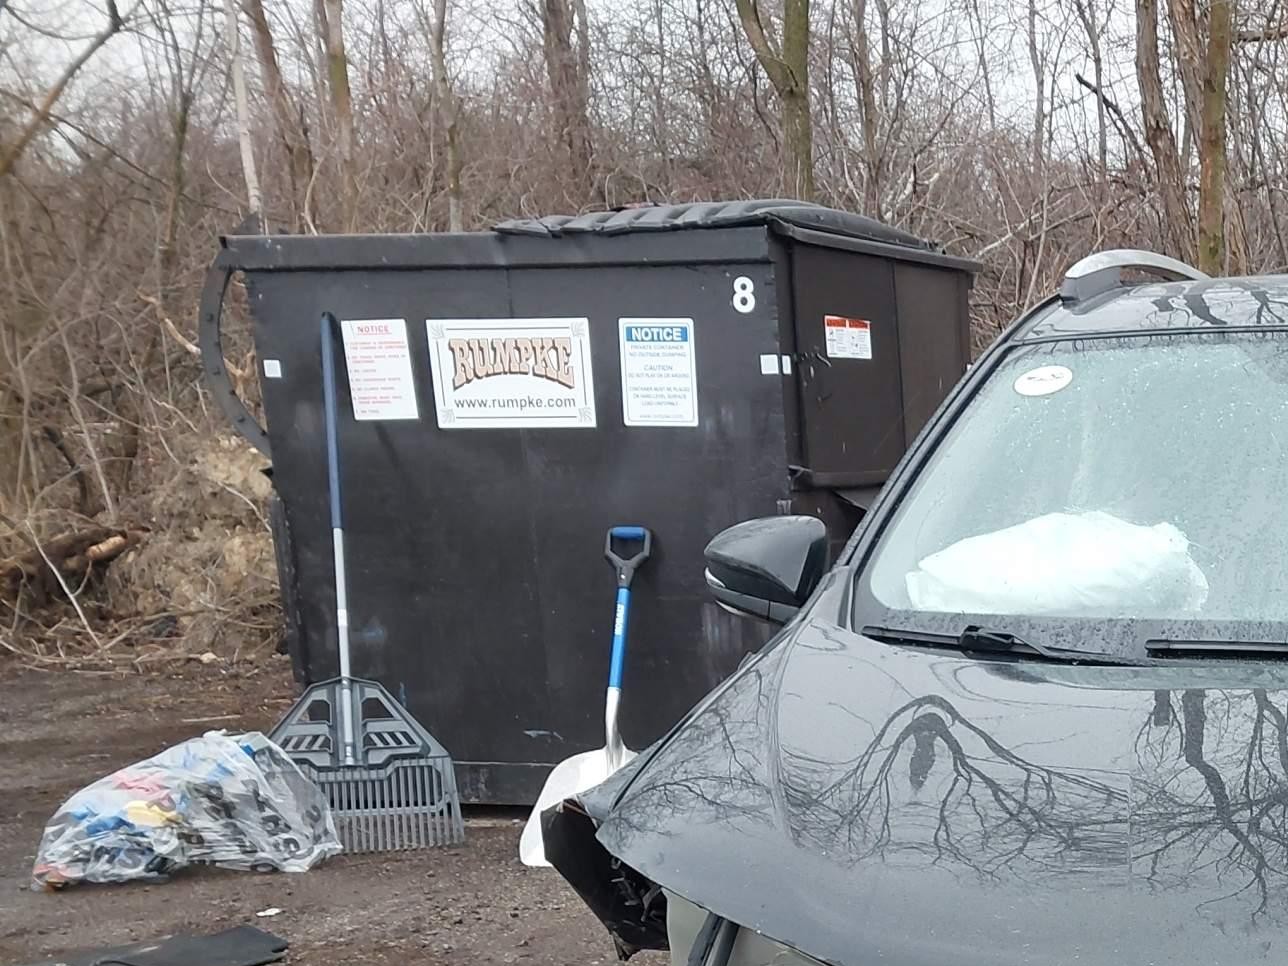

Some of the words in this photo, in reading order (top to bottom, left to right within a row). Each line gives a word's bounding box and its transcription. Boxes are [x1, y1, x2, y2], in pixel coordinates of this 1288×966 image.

[733, 276, 756, 313] 8
[357, 324, 390, 334] NOTICE
[631, 327, 682, 341] NOTICE
[448, 336, 575, 391] RUMPKE
[454, 395, 576, 411] www.rumpke.com
